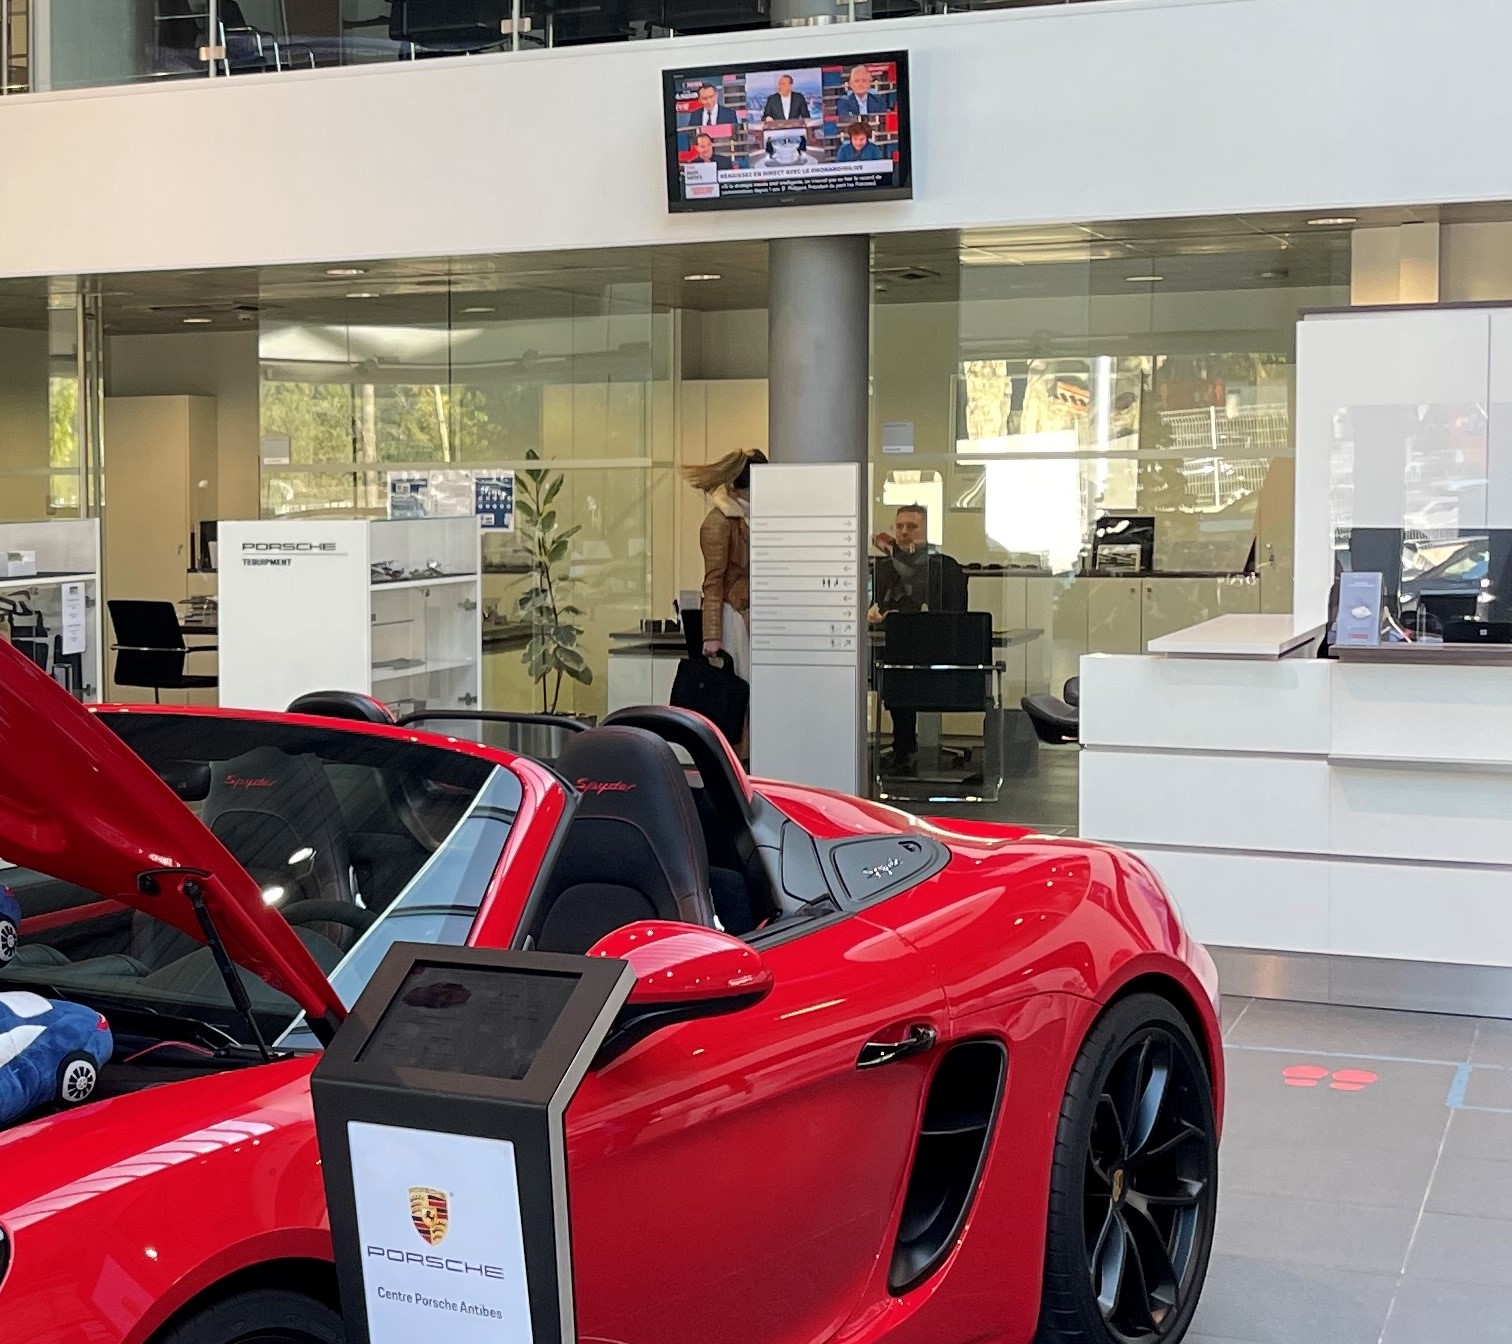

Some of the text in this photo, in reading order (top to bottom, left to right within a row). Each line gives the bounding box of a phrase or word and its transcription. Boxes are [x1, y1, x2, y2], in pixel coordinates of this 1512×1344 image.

[242, 543, 336, 551] PORSCHE
[576, 777, 637, 795] Spyder
[367, 1245, 505, 1280] PORSCHE
[377, 1286, 503, 1320] Centre Porsche Antibes
